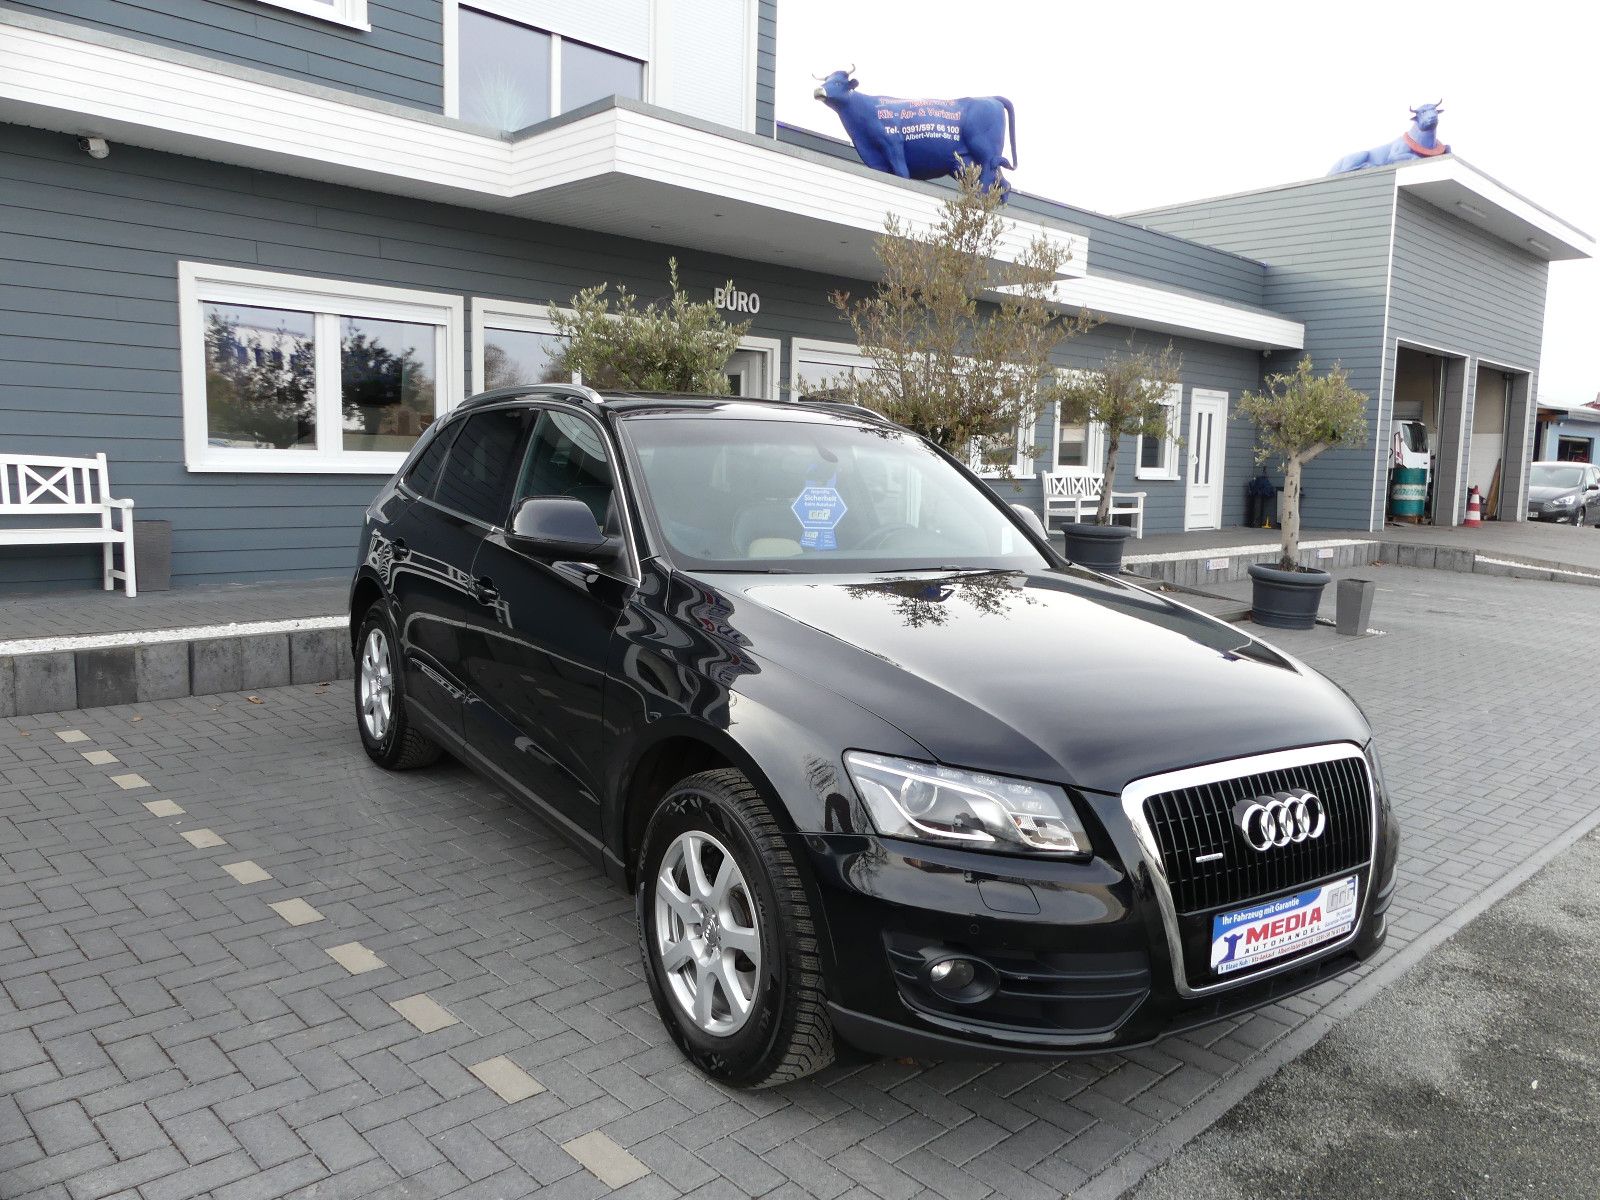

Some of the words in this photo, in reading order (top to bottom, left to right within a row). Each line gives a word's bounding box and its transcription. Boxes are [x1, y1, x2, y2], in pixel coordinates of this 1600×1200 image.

[885, 126, 899, 134] Tel.
[902, 123, 935, 134] 0391/597
[947, 125, 960, 134] 100
[714, 286, 760, 314] BÜRO
[804, 494, 837, 502] Sicherheit
[1222, 916, 1233, 925] Ihr
[1233, 909, 1264, 923] Fahrzeug
[1264, 905, 1275, 915] mit
[1275, 898, 1300, 911] Garantie
[1246, 906, 1322, 945] MEDIA
[1244, 925, 1321, 955] AUTOHANDEL
